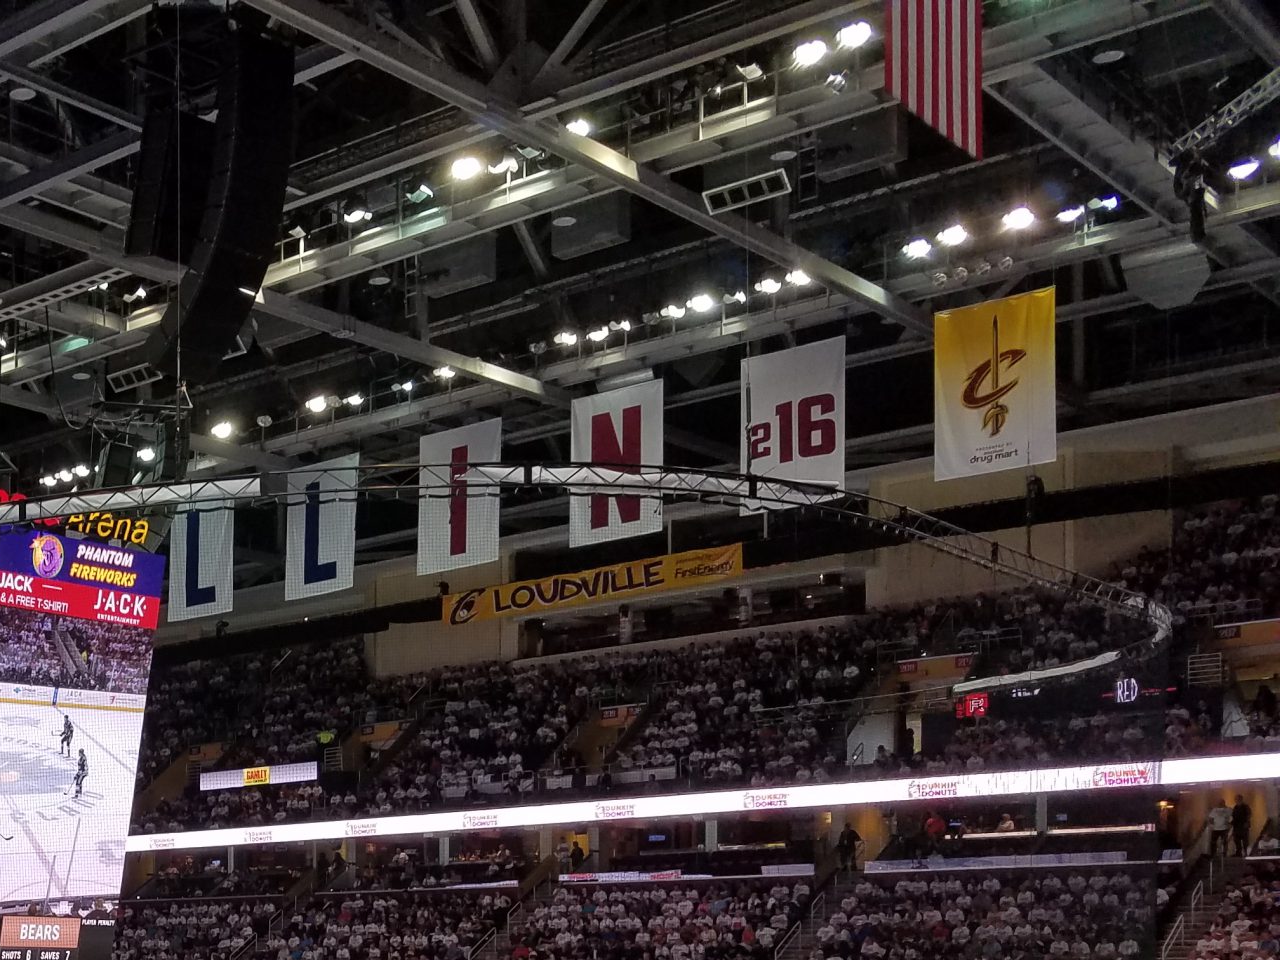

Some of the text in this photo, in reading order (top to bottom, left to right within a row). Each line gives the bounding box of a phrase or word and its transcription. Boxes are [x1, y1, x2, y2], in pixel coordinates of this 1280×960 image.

[751, 393, 836, 463] 216
[591, 405, 641, 530] N
[969, 454, 992, 464] drug
[994, 449, 1019, 460] mart
[66, 512, 149, 545] Arena
[304, 481, 337, 586] L
[76, 544, 134, 568] PHANTOM
[185, 511, 217, 608] L
[70, 563, 137, 588] FIREWORKS
[674, 560, 734, 579] FirstEnergy
[493, 560, 665, 613] LOUDVILLE
[0, 592, 7, 602] &
[7, 593, 15, 604] A
[15, 594, 35, 608] FREE
[37, 597, 69, 612] T-SHIRT!
[1116, 678, 1138, 703] RED
[921, 789, 958, 797] DONUTS
[19, 922, 60, 941] BEARS
[81, 918, 115, 927] PLAYER PENALTY
[1, 951, 21, 960] SHOTS
[40, 951, 60, 960] SAVES
